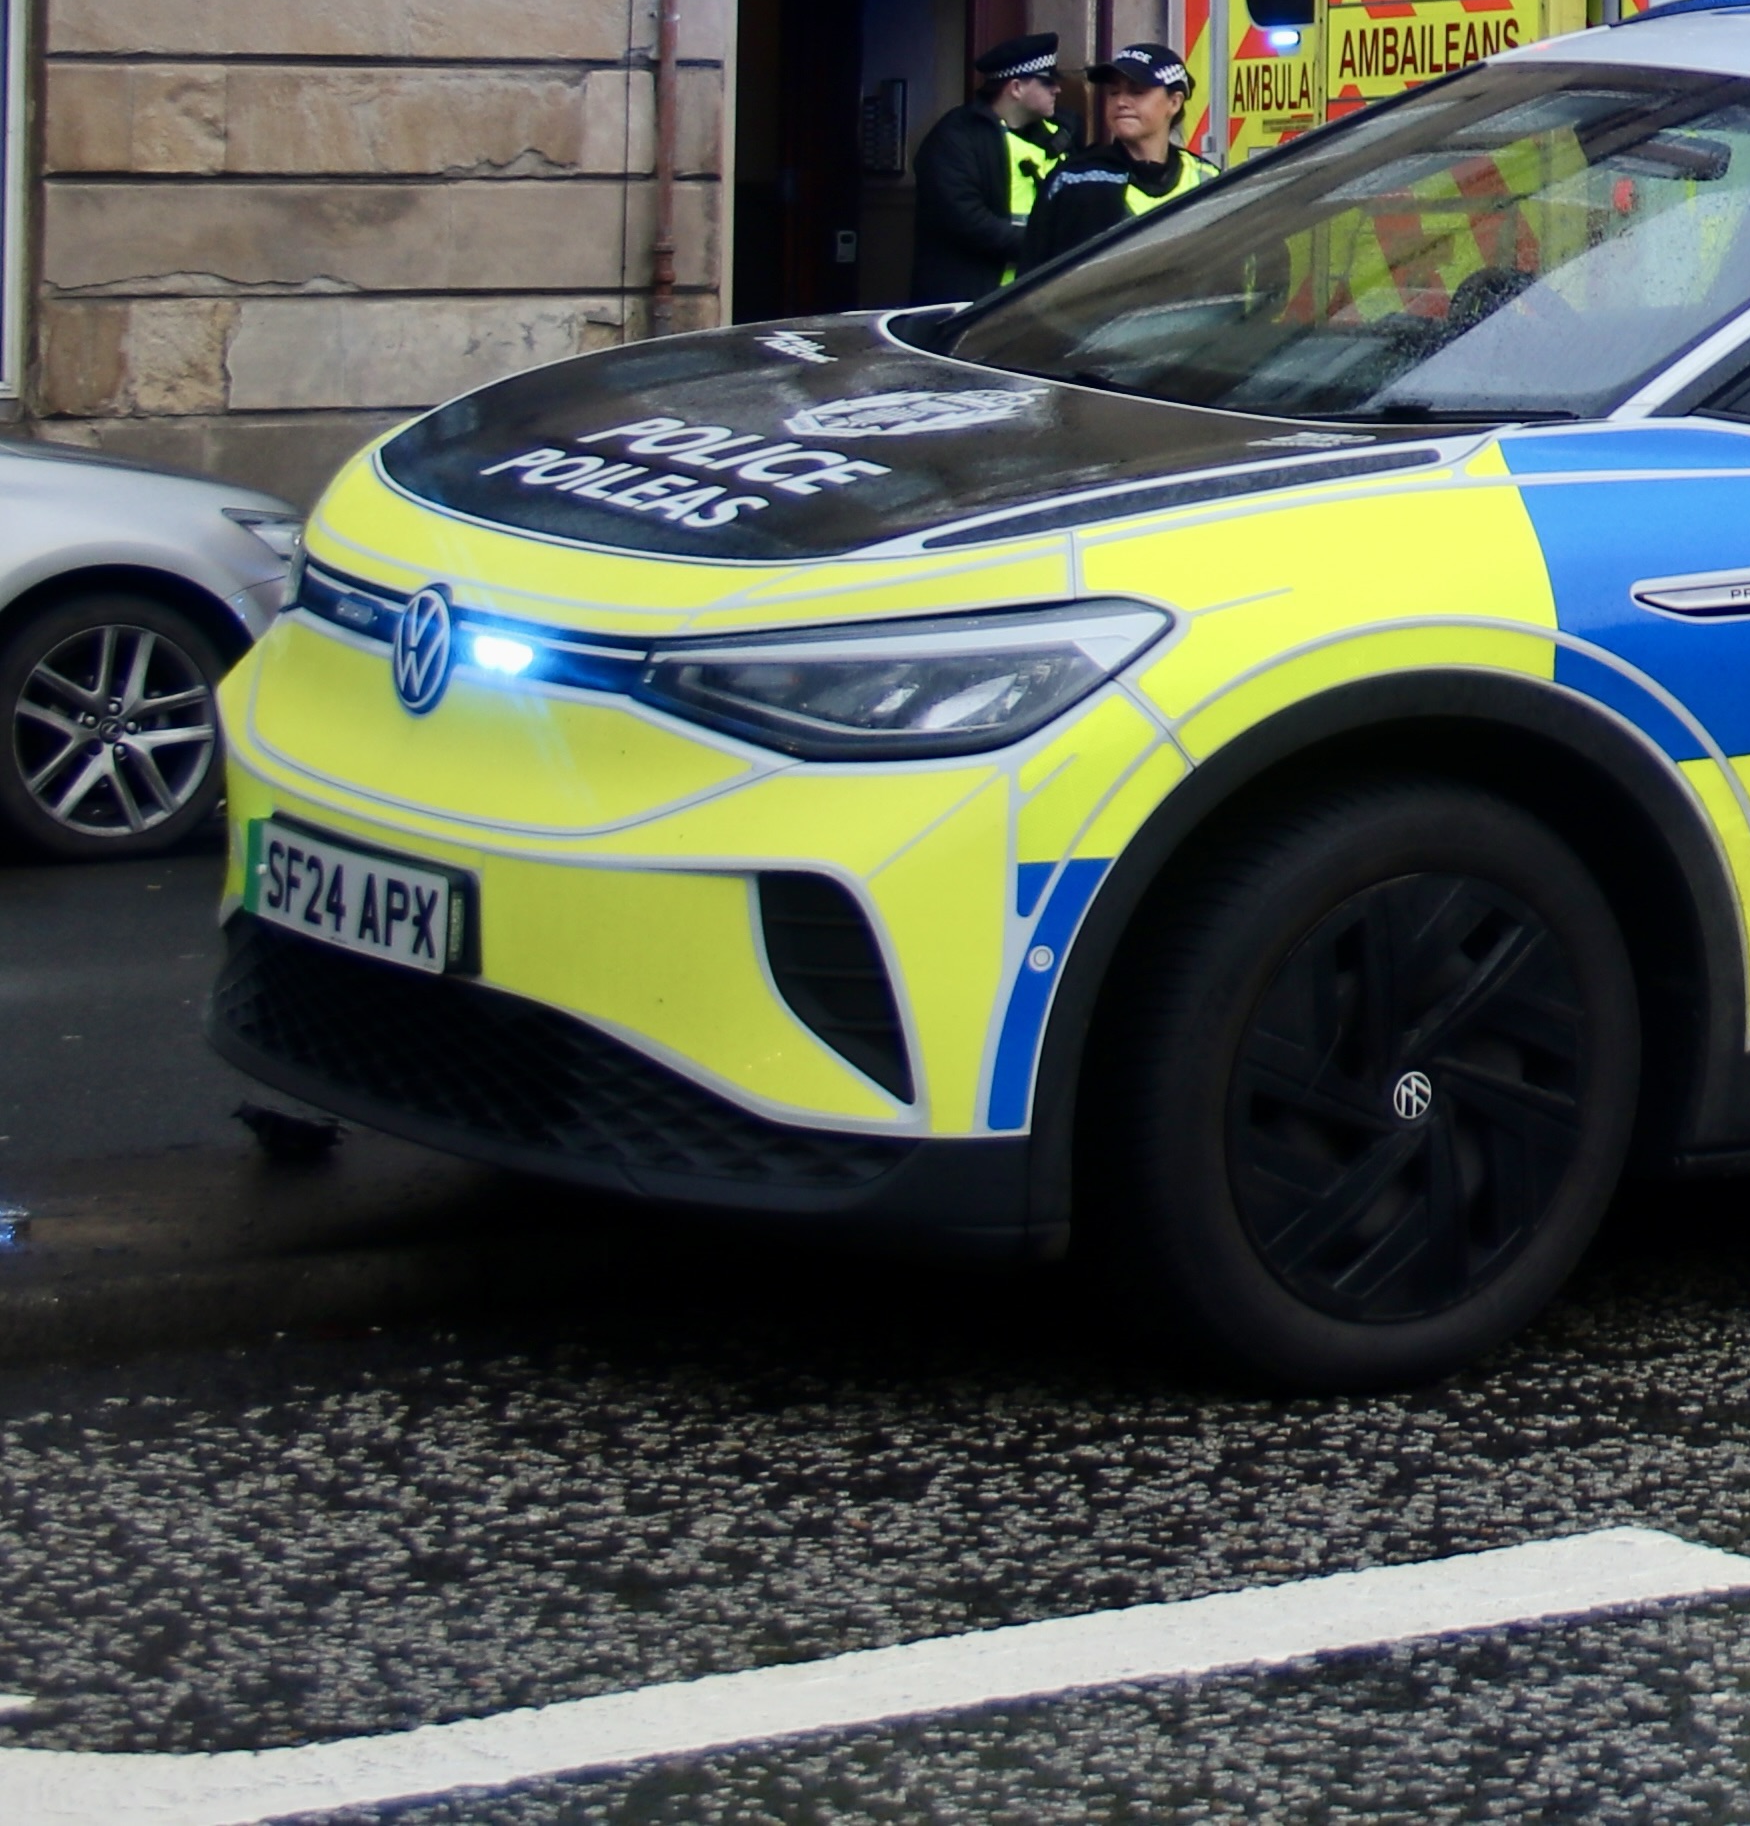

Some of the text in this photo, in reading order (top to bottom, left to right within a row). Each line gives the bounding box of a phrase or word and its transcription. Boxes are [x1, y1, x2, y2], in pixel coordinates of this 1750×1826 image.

[1233, 60, 1315, 113] AMBULA
[1339, 18, 1520, 79] AMBAILEANS
[480, 447, 771, 528] POILEAS
[577, 416, 893, 495] POLICE
[266, 839, 347, 933] SF24
[358, 871, 440, 960] APX
